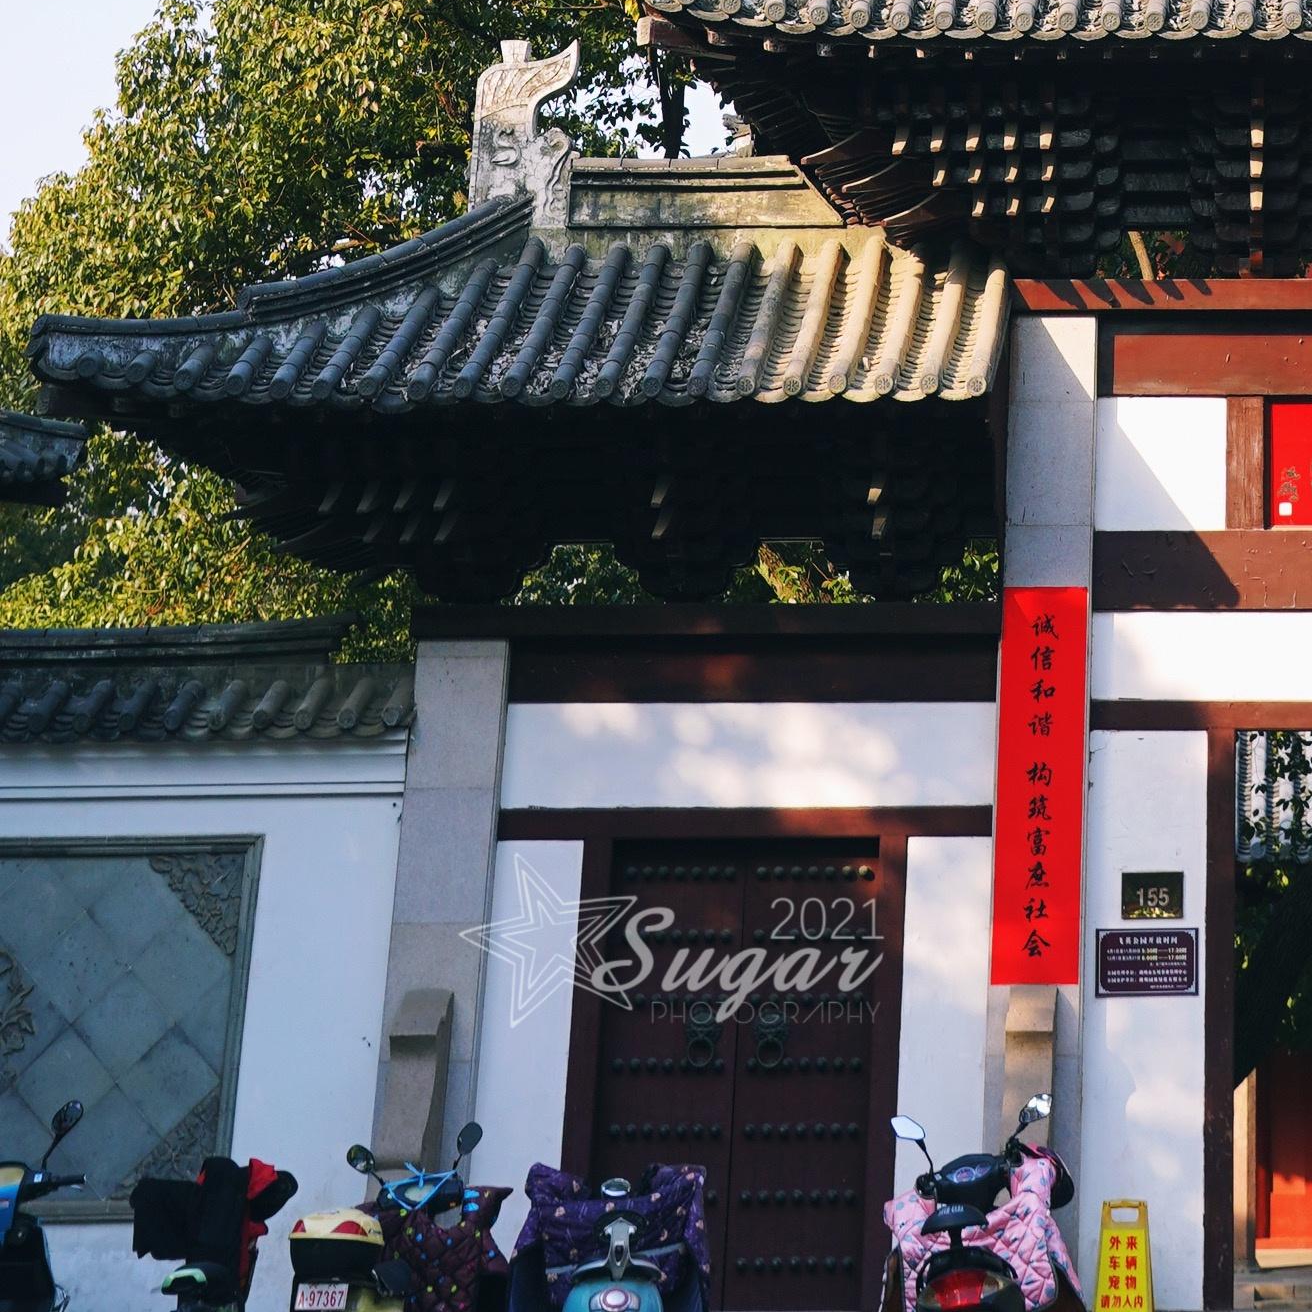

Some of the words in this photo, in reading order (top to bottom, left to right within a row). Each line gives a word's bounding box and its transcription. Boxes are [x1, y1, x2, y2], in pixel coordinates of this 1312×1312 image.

[1027, 615, 1059, 737] 诚信和谐
[1022, 762, 1052, 957] 构筑富庶社会
[1136, 887, 1170, 907] 155
[1108, 1235, 1138, 1251] 外来
